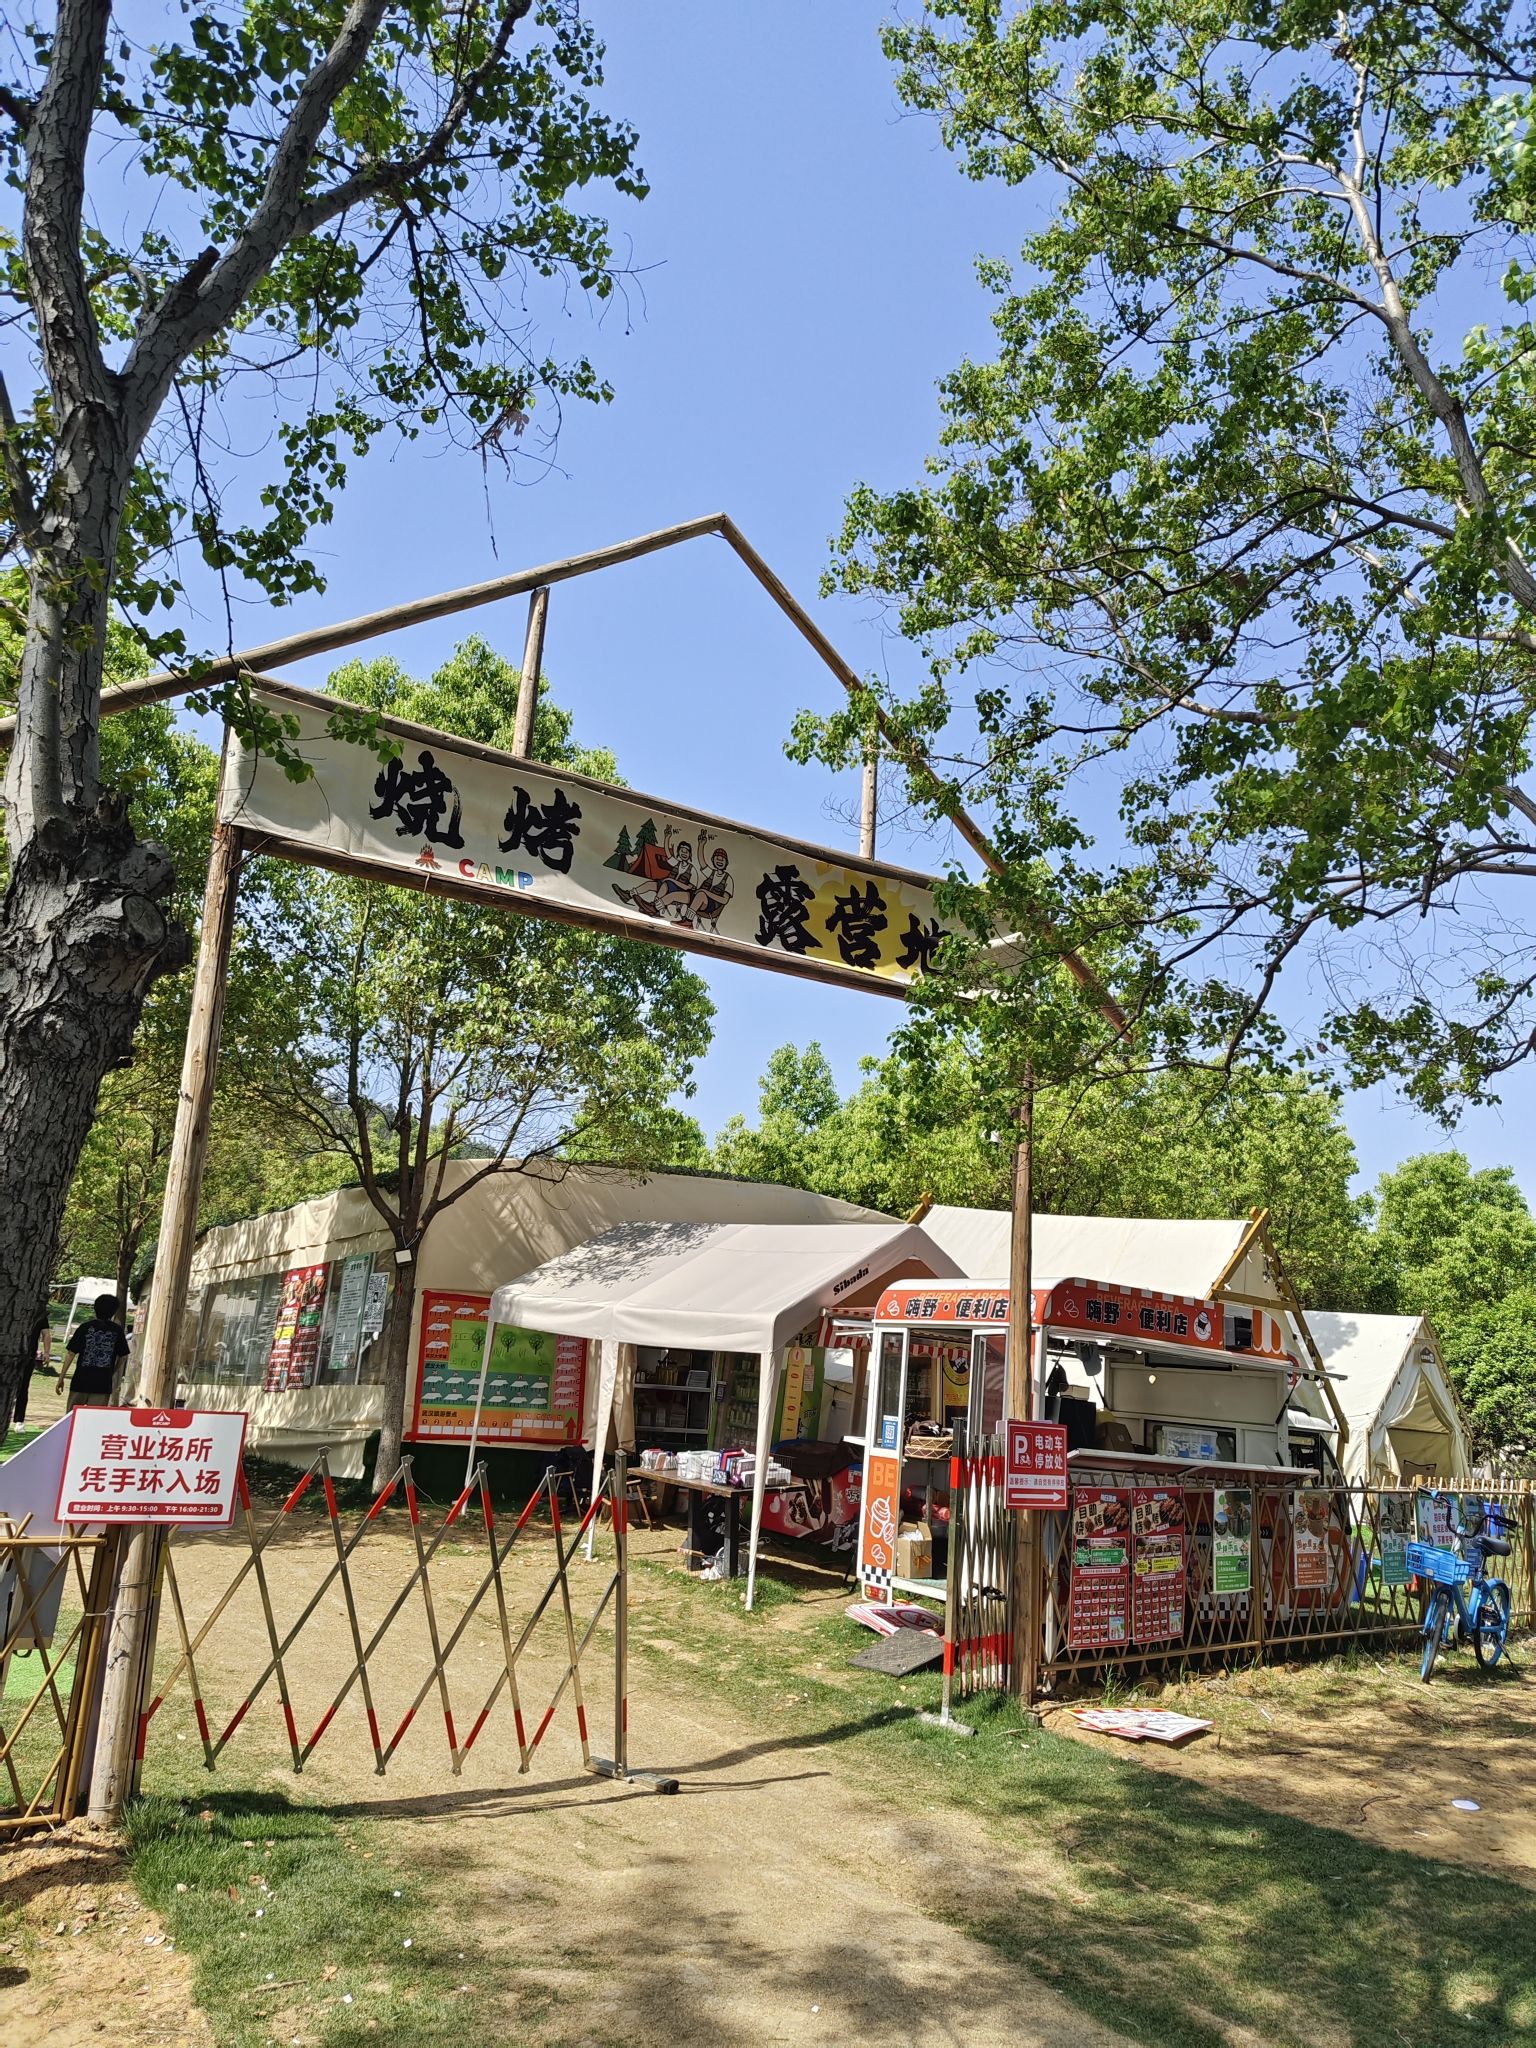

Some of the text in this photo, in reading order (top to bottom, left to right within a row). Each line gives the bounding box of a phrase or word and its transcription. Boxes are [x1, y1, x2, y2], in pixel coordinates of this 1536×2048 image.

[369, 750, 583, 875] 烧烤
[458, 858, 534, 890] CAMP
[833, 1267, 869, 1296] Sibada
[100, 1434, 214, 1462] 营业场所
[1014, 1435, 1028, 1464] P
[1035, 1434, 1063, 1451] 电动车
[1035, 1453, 1063, 1470] 停放处
[79, 1466, 221, 1495] 凭手环入场
